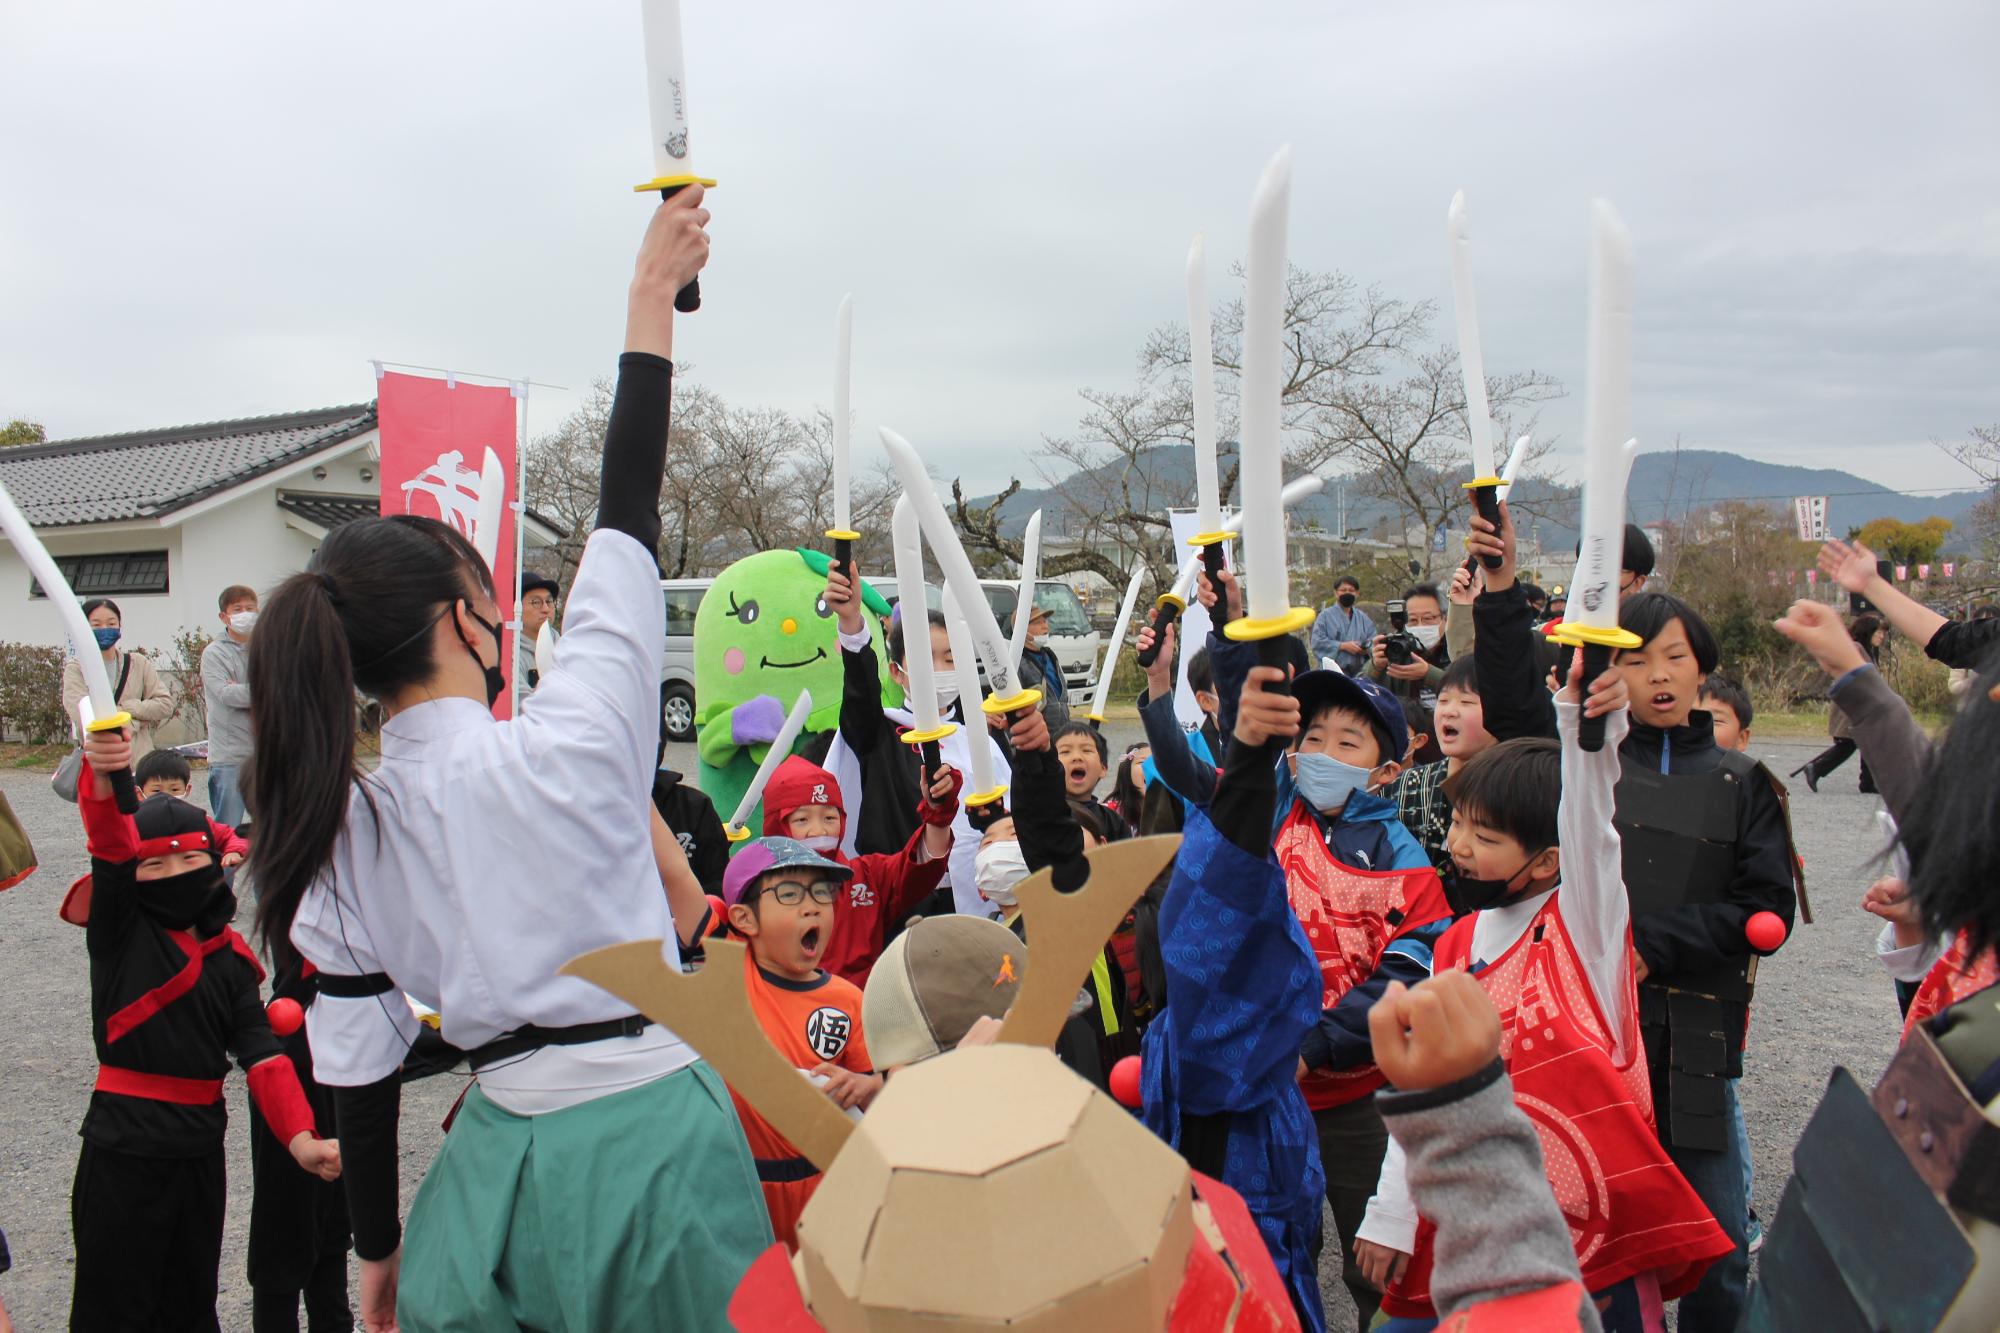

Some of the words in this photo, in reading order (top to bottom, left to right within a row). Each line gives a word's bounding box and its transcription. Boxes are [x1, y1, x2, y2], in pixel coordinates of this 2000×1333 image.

[668, 78, 684, 121] IKUSA
[811, 783, 828, 803] 忍
[850, 883, 875, 907] 忍
[809, 1010, 849, 1055] 悟
